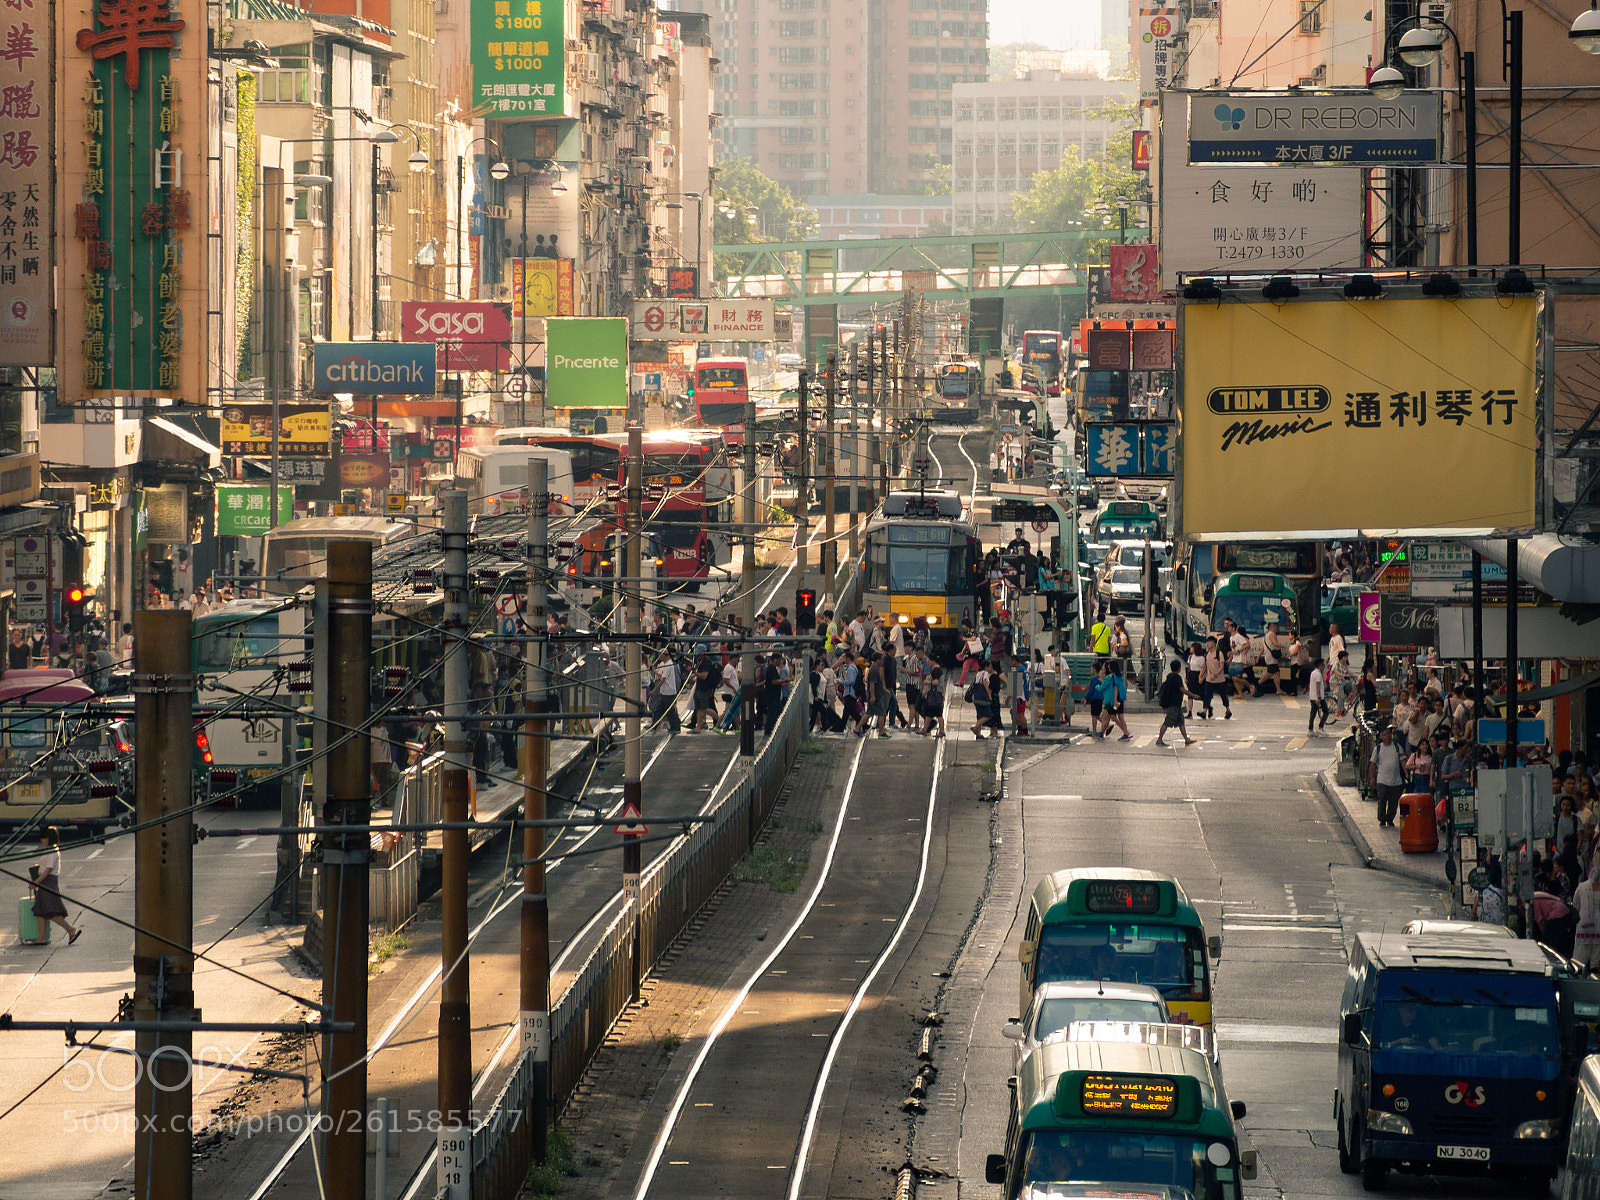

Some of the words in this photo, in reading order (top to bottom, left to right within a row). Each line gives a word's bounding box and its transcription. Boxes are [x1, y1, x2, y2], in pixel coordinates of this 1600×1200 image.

[495, 17, 542, 30] $1800
[1153, 20, 1168, 35] 拆
[488, 41, 549, 57] 簡單遺囑
[495, 58, 542, 71] $1000
[481, 83, 556, 97] 元朗匯豐大廈
[491, 99, 546, 112] 7樓701室
[1255, 107, 1293, 130] DR
[1301, 106, 1416, 130] REBORN
[1275, 145, 1325, 161] 本大廈
[1329, 145, 1353, 160] 3/F
[1208, 179, 1316, 204] 食好啲
[22, 183, 40, 277] 天然生晒
[1216, 246, 1263, 259] T:2479
[1271, 246, 1304, 259] 1330
[721, 309, 763, 323] 財務
[554, 354, 619, 369] Pricerite
[326, 359, 424, 382] citibank
[1219, 391, 1269, 410] TOM
[1280, 389, 1321, 409] LEE
[1344, 389, 1519, 428] 通利琴行
[1221, 414, 1333, 451] Music
[35, 567, 45, 575] 12
[1458, 803, 1470, 813] B2
[624, 878, 640, 887] 590
[625, 889, 639, 899] PL
[523, 1017, 543, 1029] 590
[524, 1032, 540, 1043] PL
[1444, 1081, 1486, 1107] G4S
[442, 1140, 465, 1152] 590
[1440, 1147, 1455, 1157] NU
[1459, 1148, 1488, 1159] 3040
[443, 1156, 463, 1168] PL
[445, 1172, 461, 1184] 18
